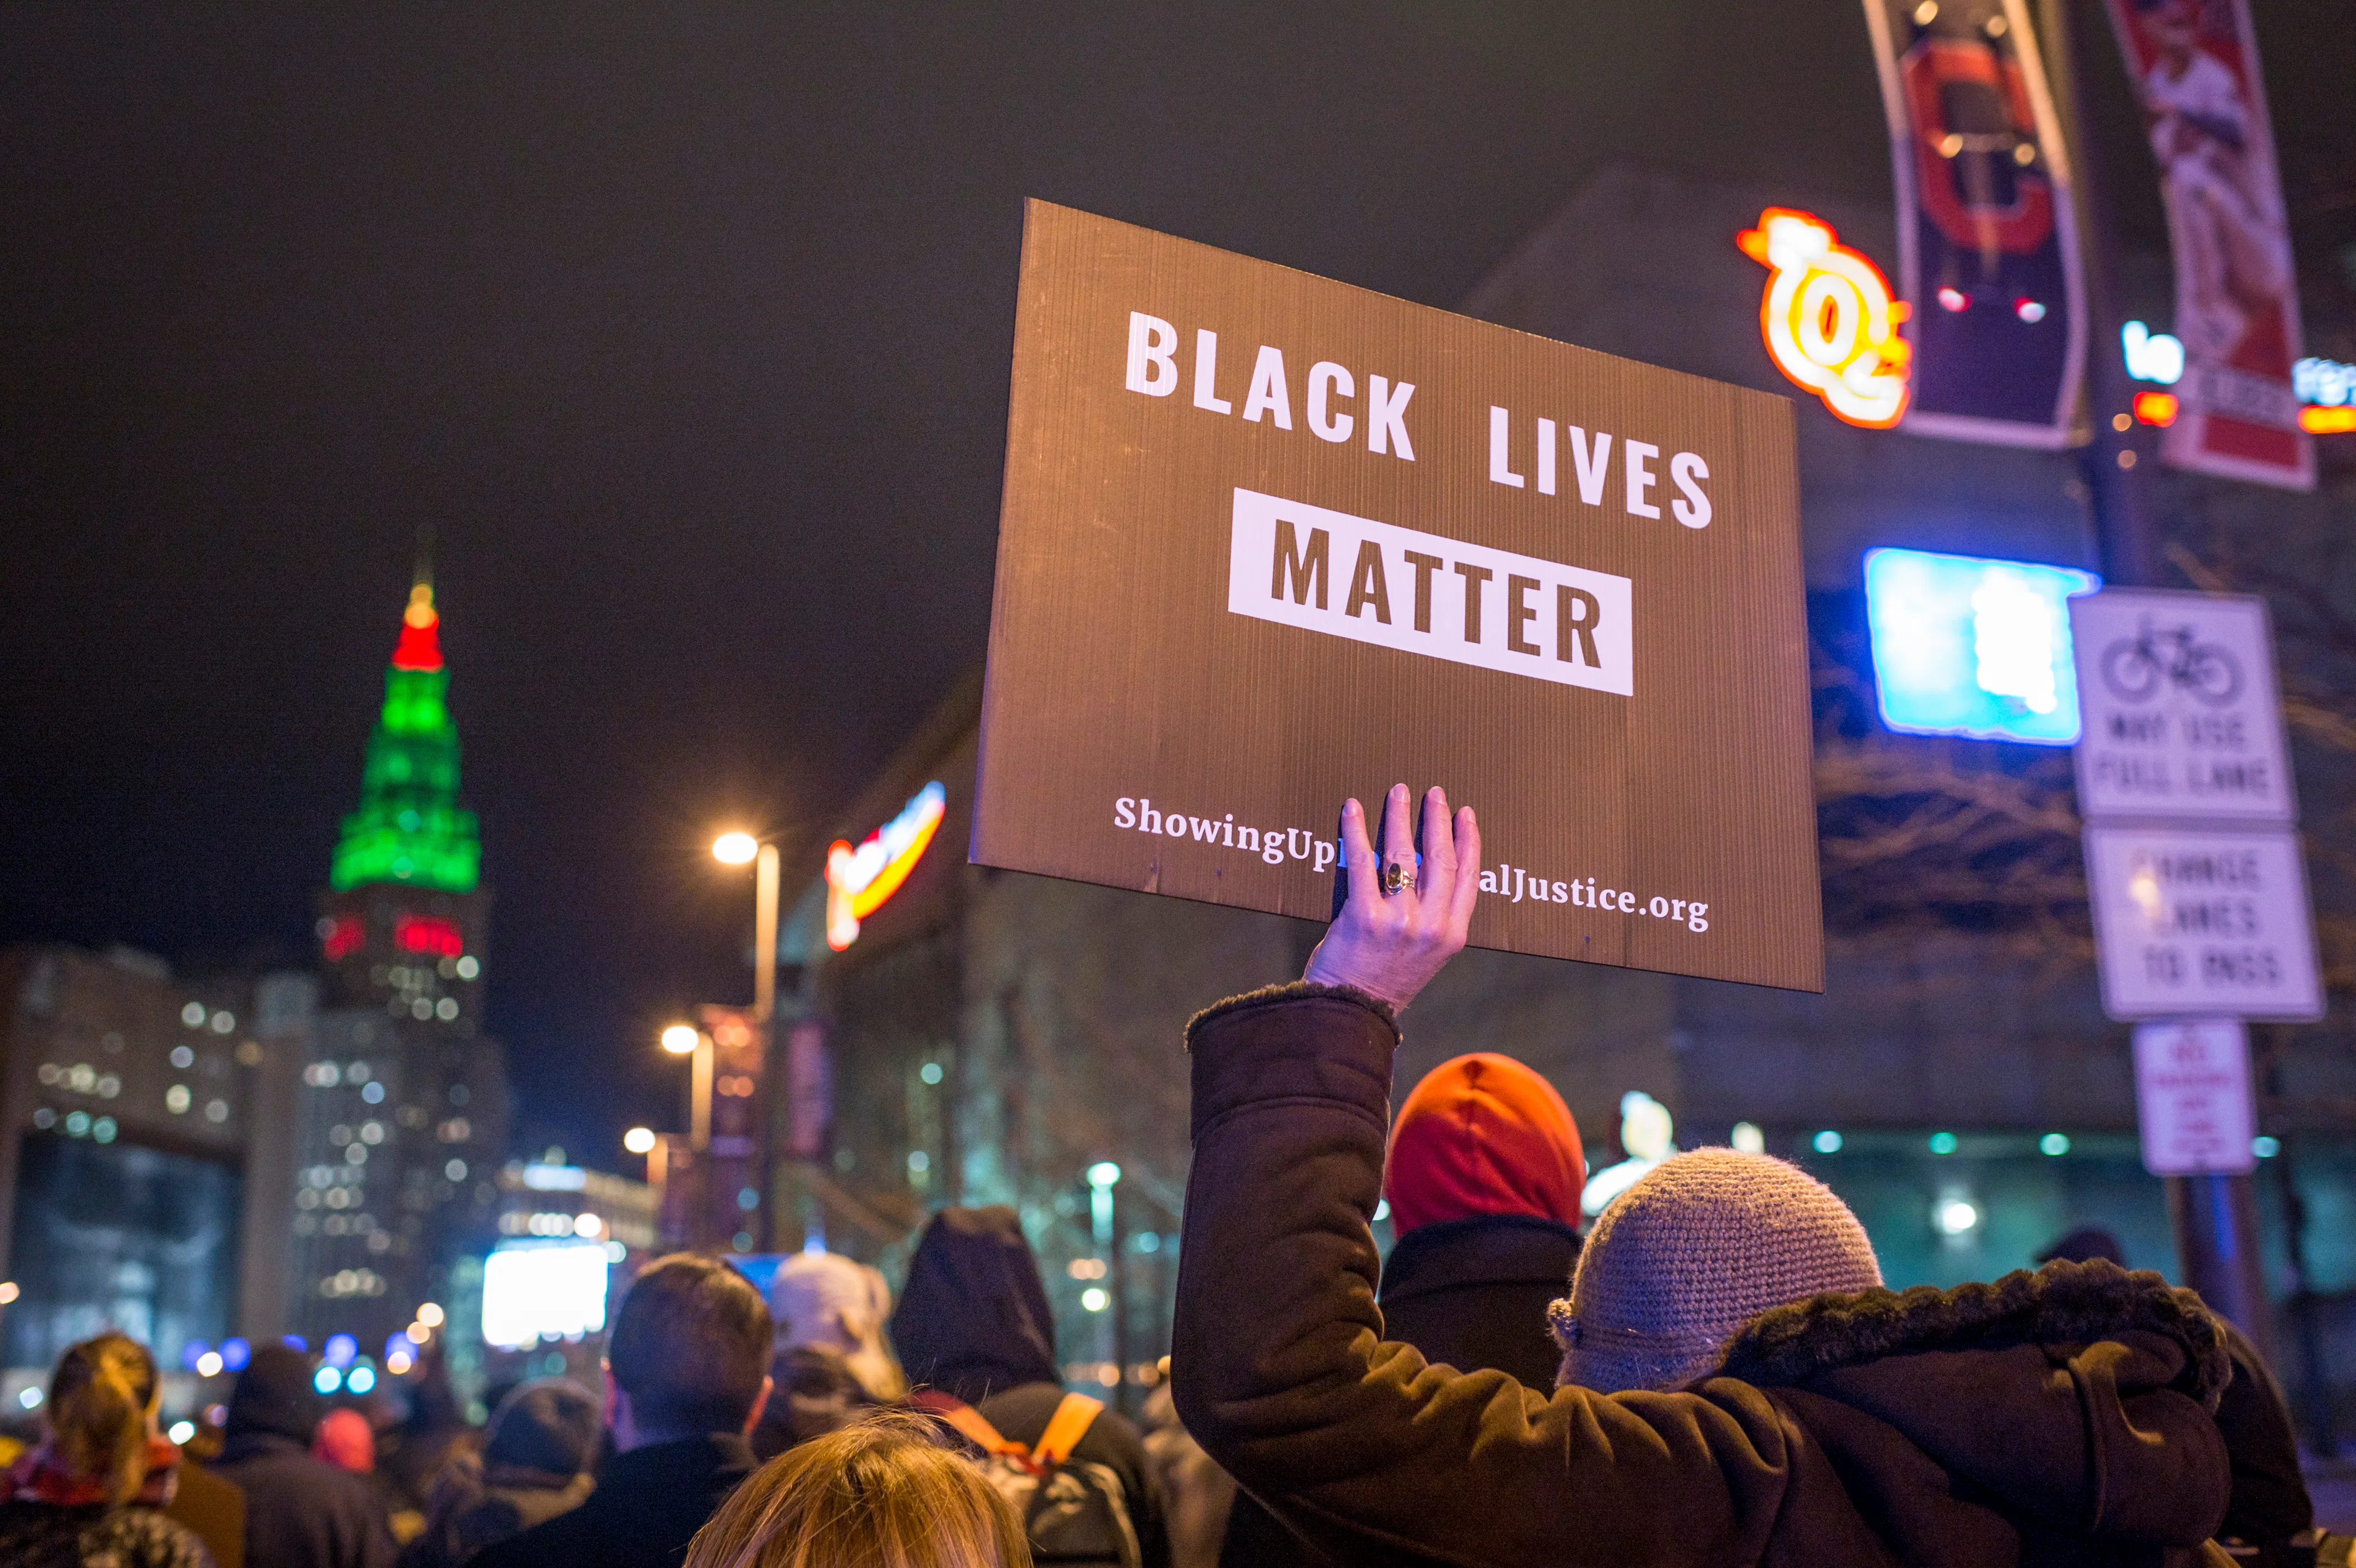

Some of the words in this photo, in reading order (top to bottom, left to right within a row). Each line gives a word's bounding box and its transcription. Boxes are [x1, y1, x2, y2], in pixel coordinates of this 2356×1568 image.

[1125, 310, 1416, 462] BLACK
[1489, 405, 1713, 530] LIVES
[1271, 518, 1602, 669] MATTER
[2184, 711, 2246, 749] USE
[1113, 797, 1709, 933] ShowingUpalJustice.org
